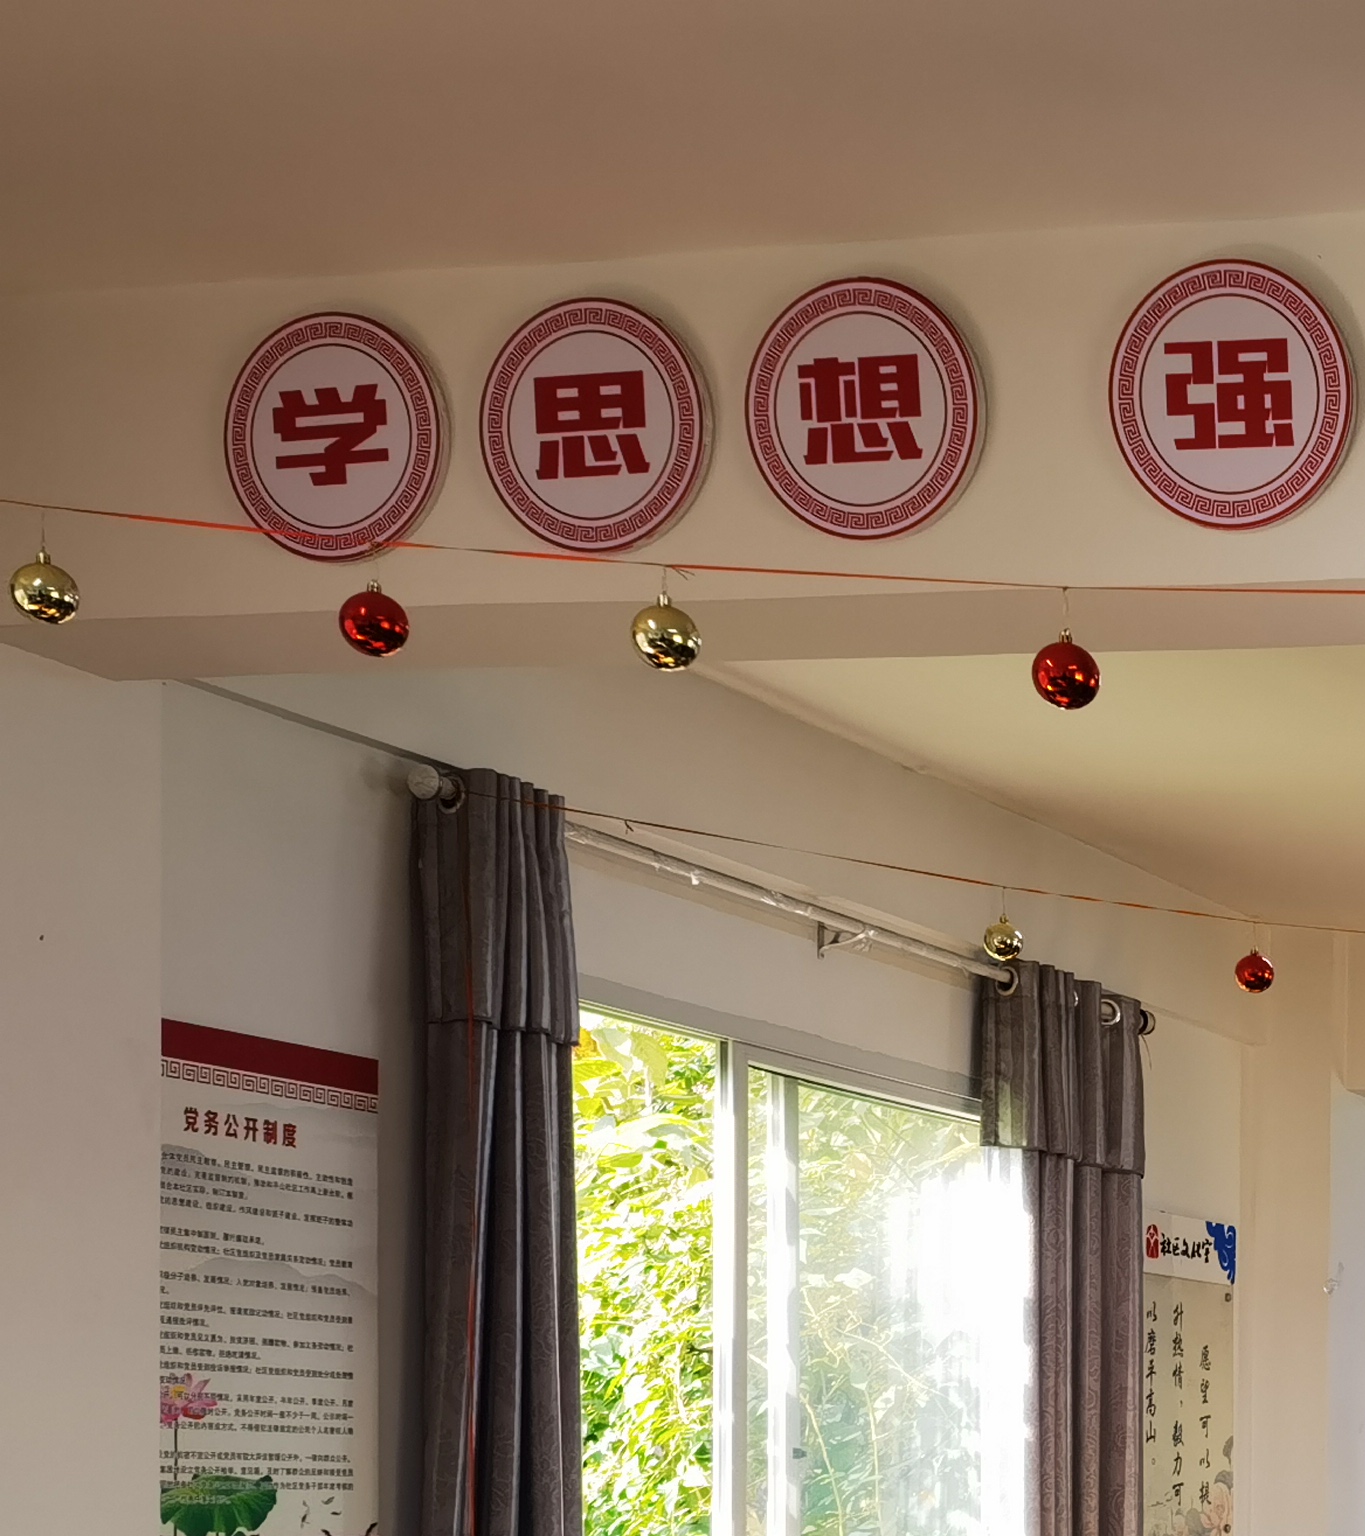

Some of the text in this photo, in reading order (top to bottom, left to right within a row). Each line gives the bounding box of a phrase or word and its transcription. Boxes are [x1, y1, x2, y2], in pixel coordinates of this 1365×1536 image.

[184, 1106, 297, 1148] 党务公开制度
